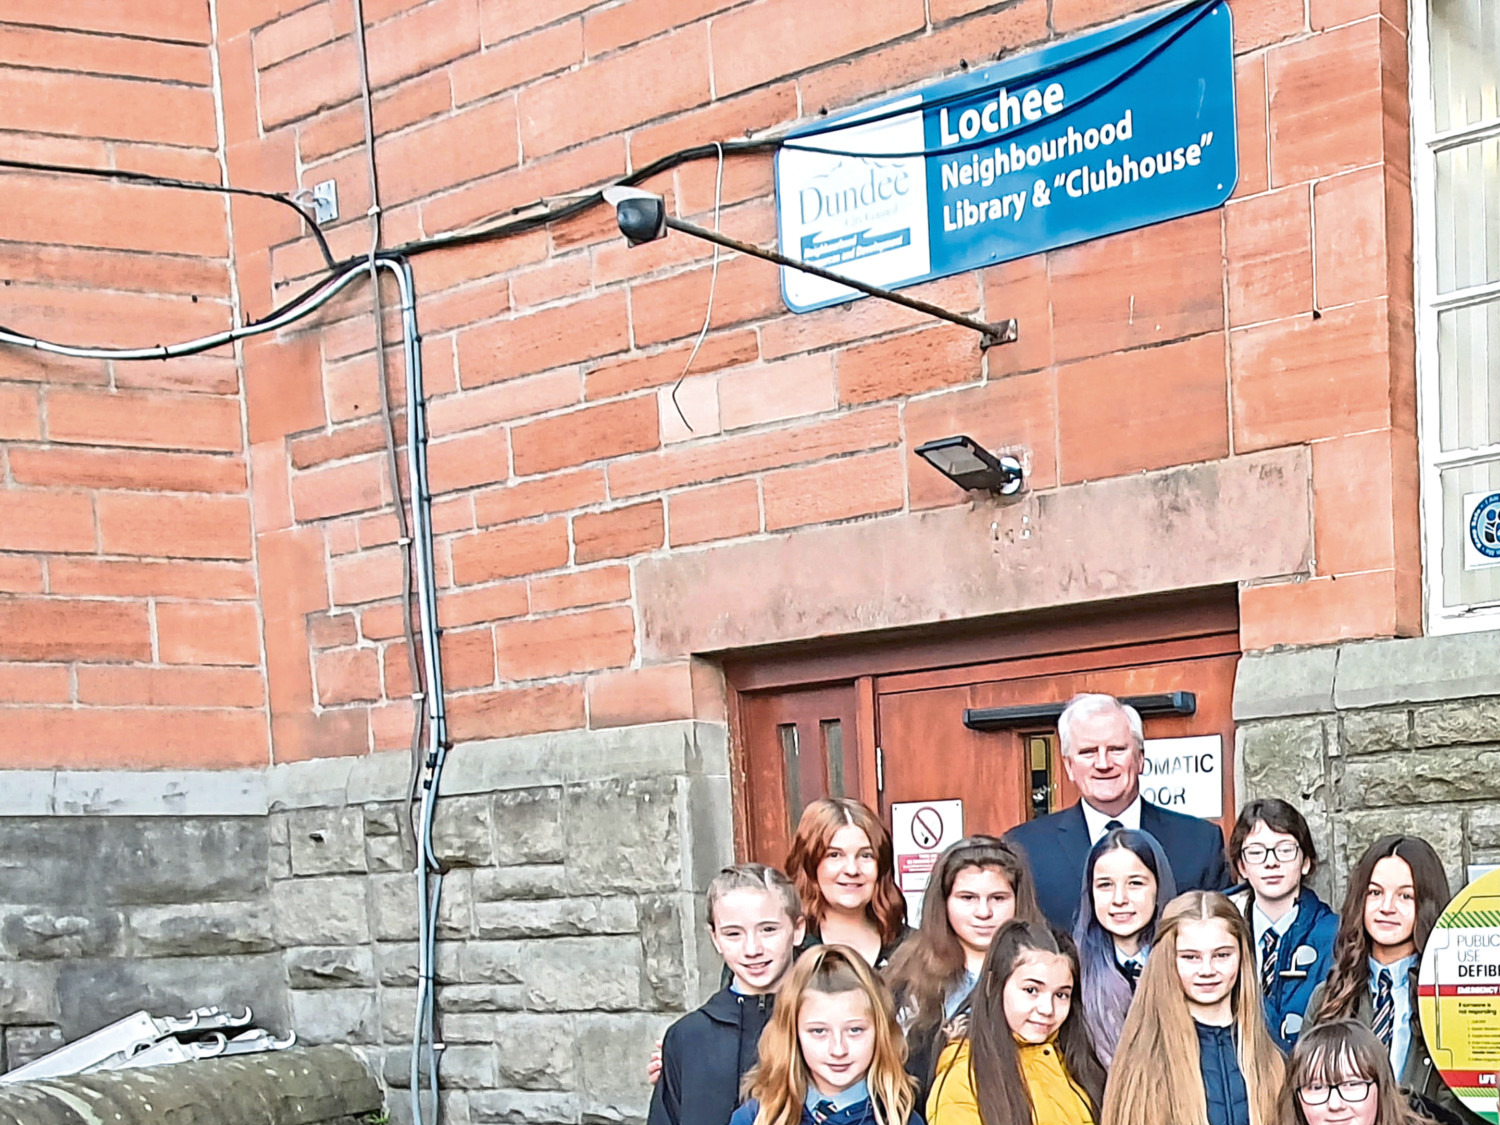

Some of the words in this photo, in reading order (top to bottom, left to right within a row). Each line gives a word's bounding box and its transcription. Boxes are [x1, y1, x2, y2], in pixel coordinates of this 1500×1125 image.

[939, 82, 1065, 146] Lochee
[941, 109, 1133, 191] Neighbourhood
[799, 167, 909, 225] Dundee
[943, 190, 1027, 232] Library
[1032, 178, 1051, 207] &
[1142, 753, 1214, 777] OMATIC
[1143, 786, 1186, 806] OOR
[1457, 934, 1500, 948] PUBLIC
[1457, 949, 1480, 963] USE
